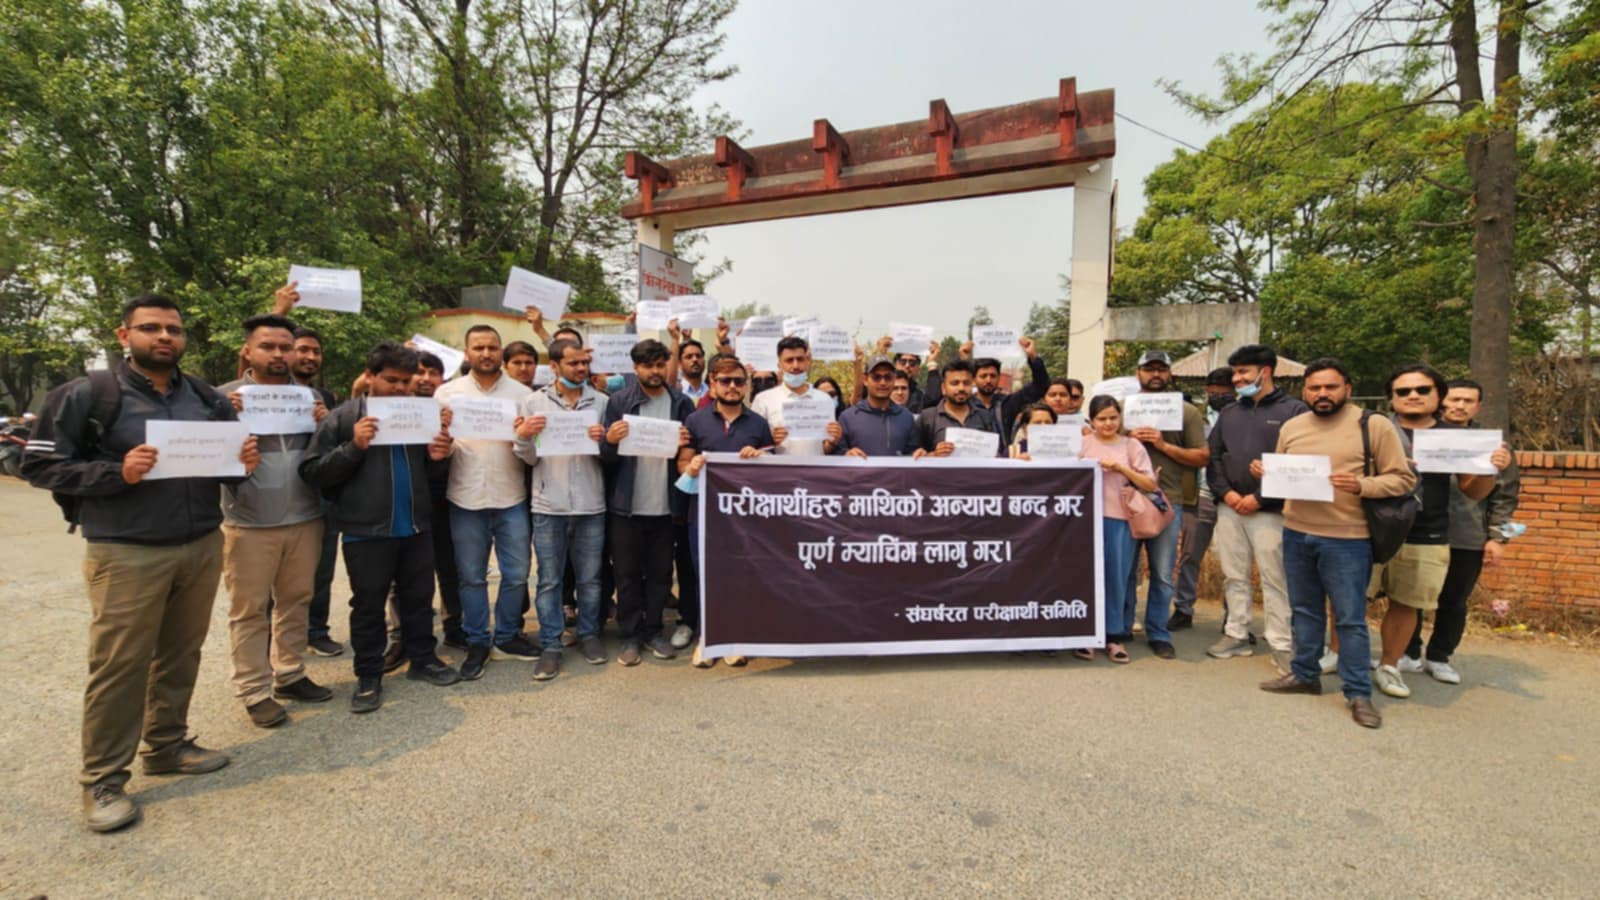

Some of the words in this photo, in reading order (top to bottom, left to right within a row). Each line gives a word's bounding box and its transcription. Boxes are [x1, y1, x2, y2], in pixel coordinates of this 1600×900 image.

[848, 487, 924, 511] माथिको
[928, 494, 1003, 516] अन्याय
[1008, 495, 1048, 517] बन्द
[1054, 495, 1085, 516] गर
[798, 537, 836, 569] पूर्ण
[841, 534, 918, 562] म्याचिंग
[923, 541, 969, 569] लागु
[905, 603, 968, 623] संघर्षरत
[973, 601, 1038, 621] परीक्षार्थी
[1040, 599, 1087, 619] समिति
